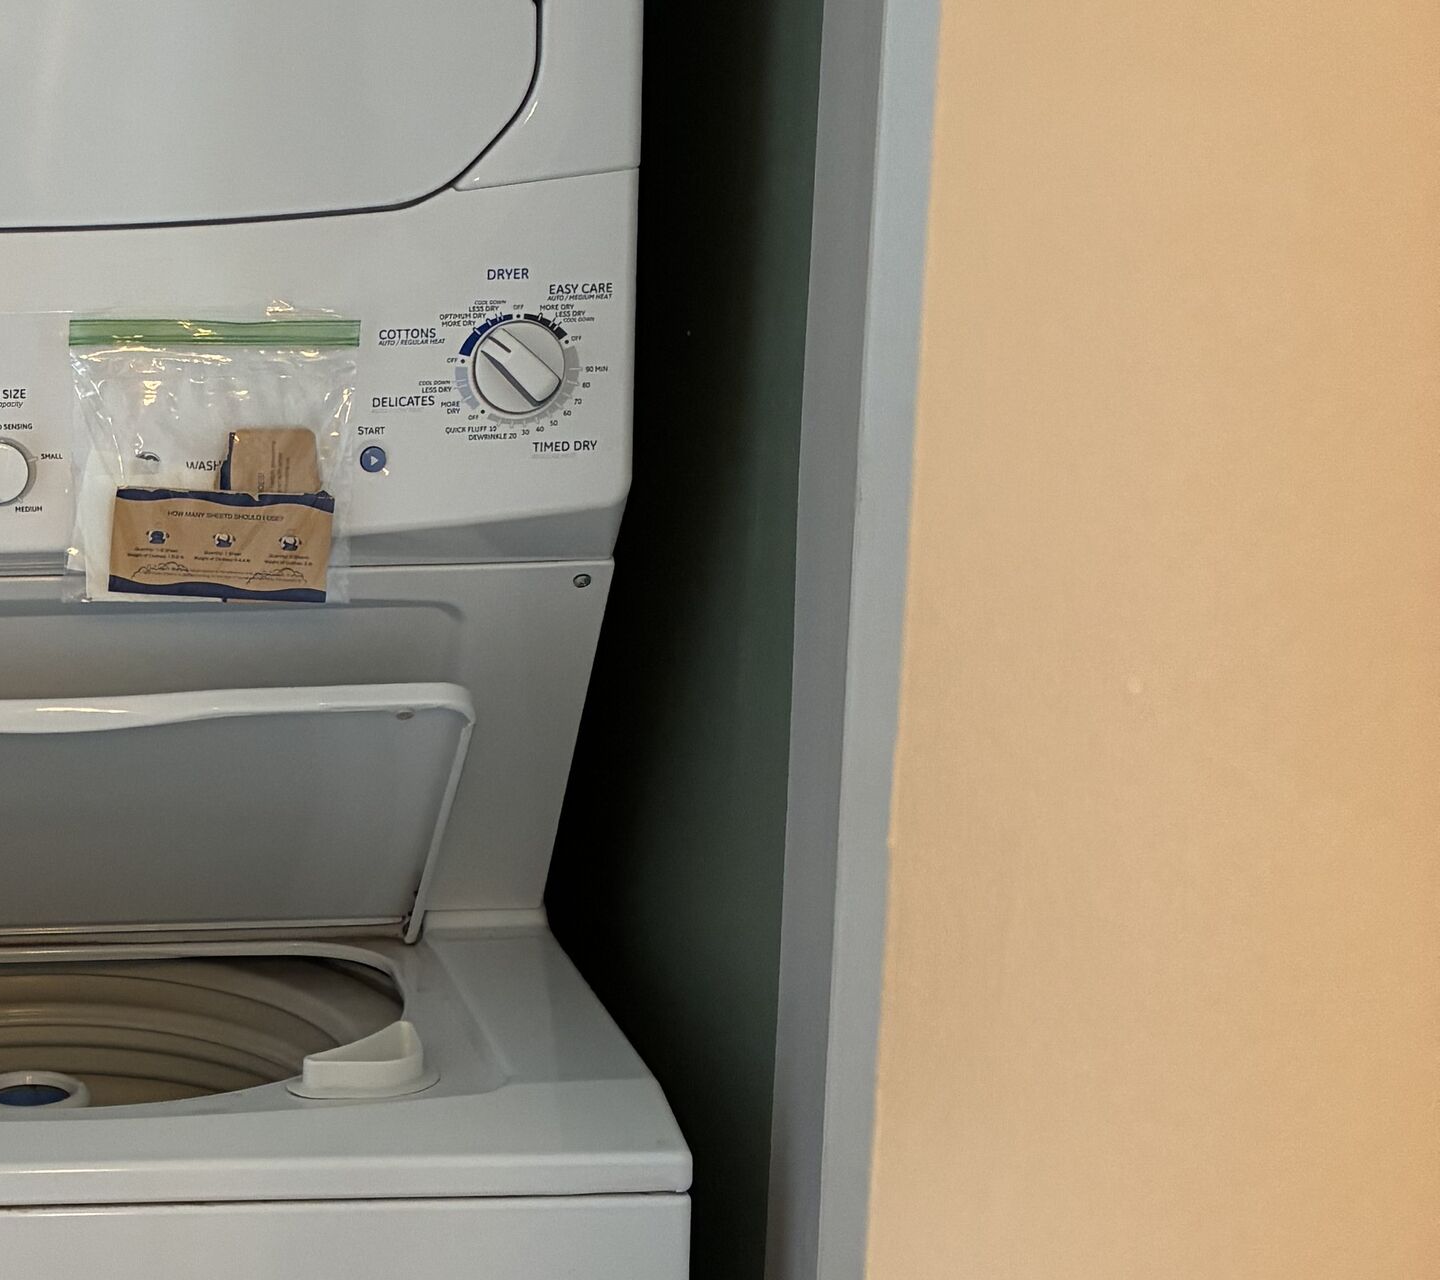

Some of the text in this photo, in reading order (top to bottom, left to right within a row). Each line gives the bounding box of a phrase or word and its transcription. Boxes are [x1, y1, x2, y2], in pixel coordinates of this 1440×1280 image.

[487, 268, 529, 280] DRYER
[549, 283, 613, 294] EASY CARE
[379, 328, 436, 340] COTTONS
[2, 389, 27, 399] SIZE
[372, 396, 435, 408] DELICATES
[357, 426, 385, 435] START
[468, 433, 507, 441] DEWRINKLE
[532, 440, 597, 452] TIMED DRY
